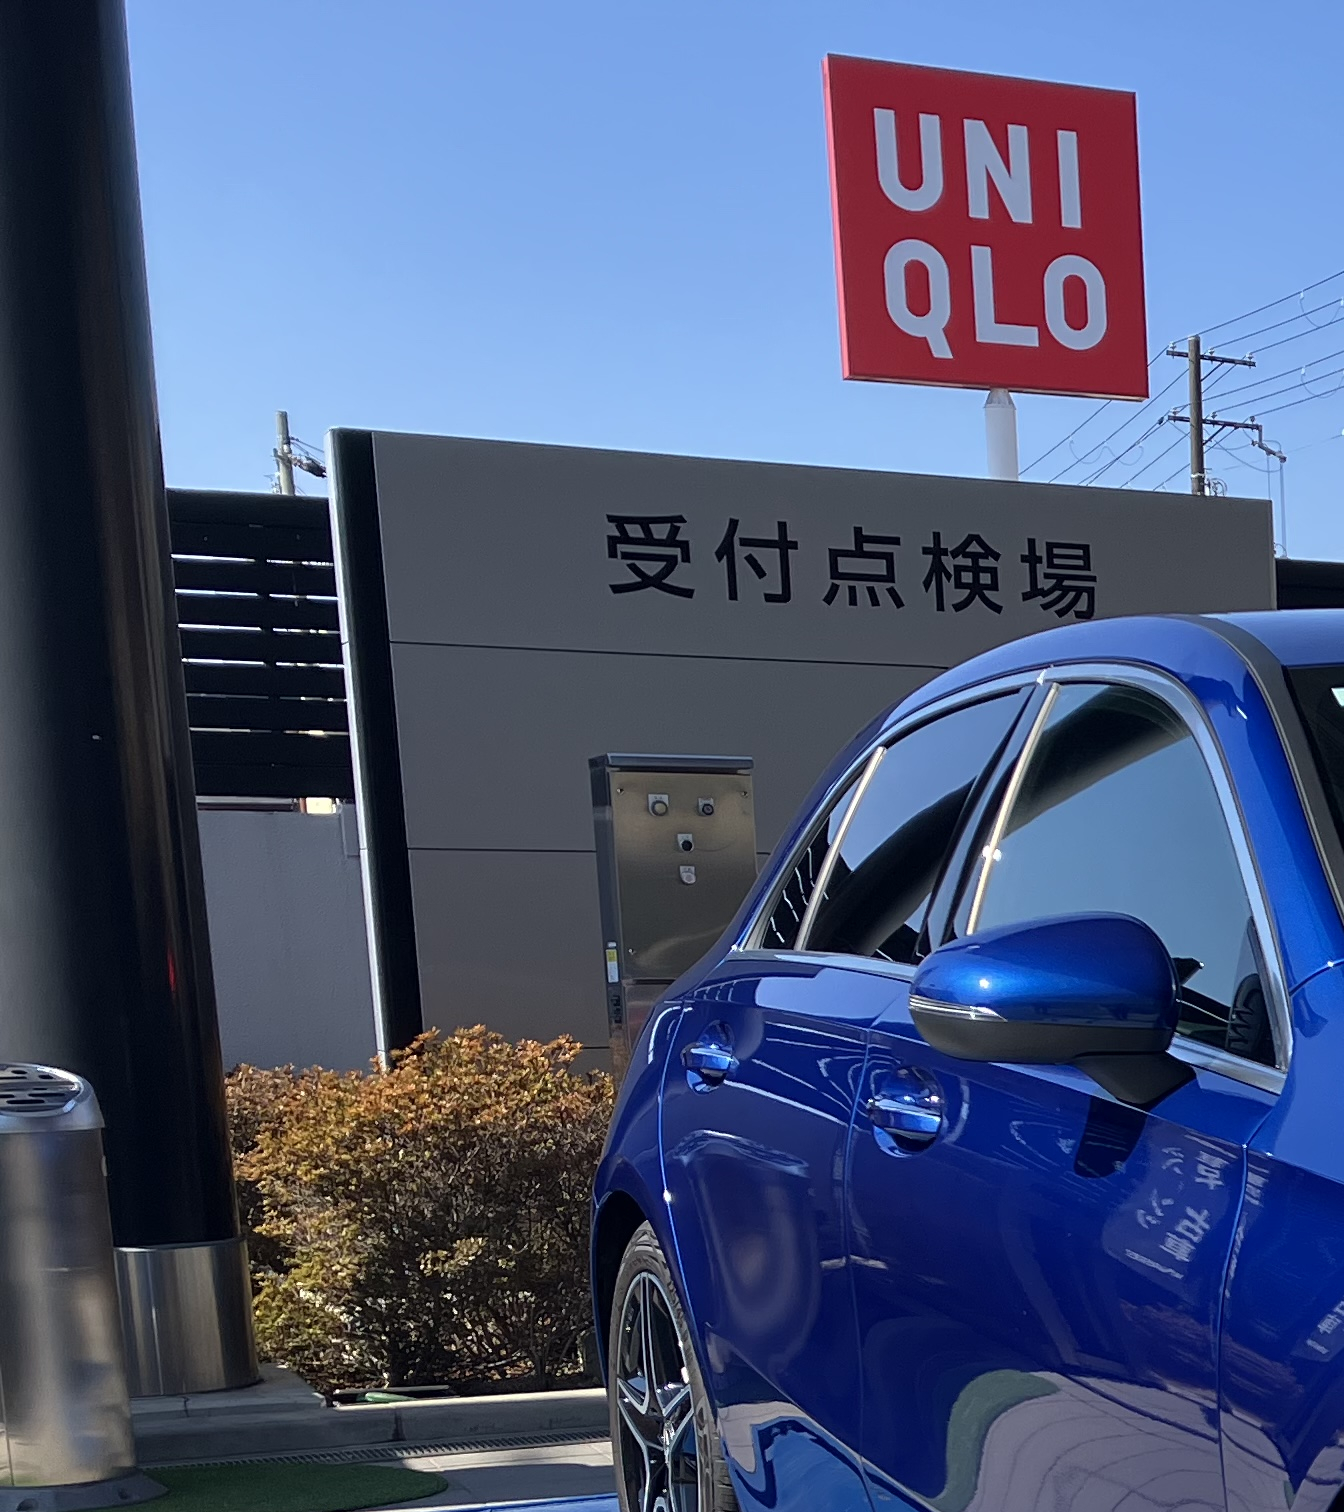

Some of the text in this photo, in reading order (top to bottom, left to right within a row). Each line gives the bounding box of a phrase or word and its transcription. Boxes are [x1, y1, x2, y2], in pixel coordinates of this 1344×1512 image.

[873, 106, 1083, 230] UNI
[880, 239, 1108, 360] QLO
[605, 513, 1100, 619] 受付点検場
